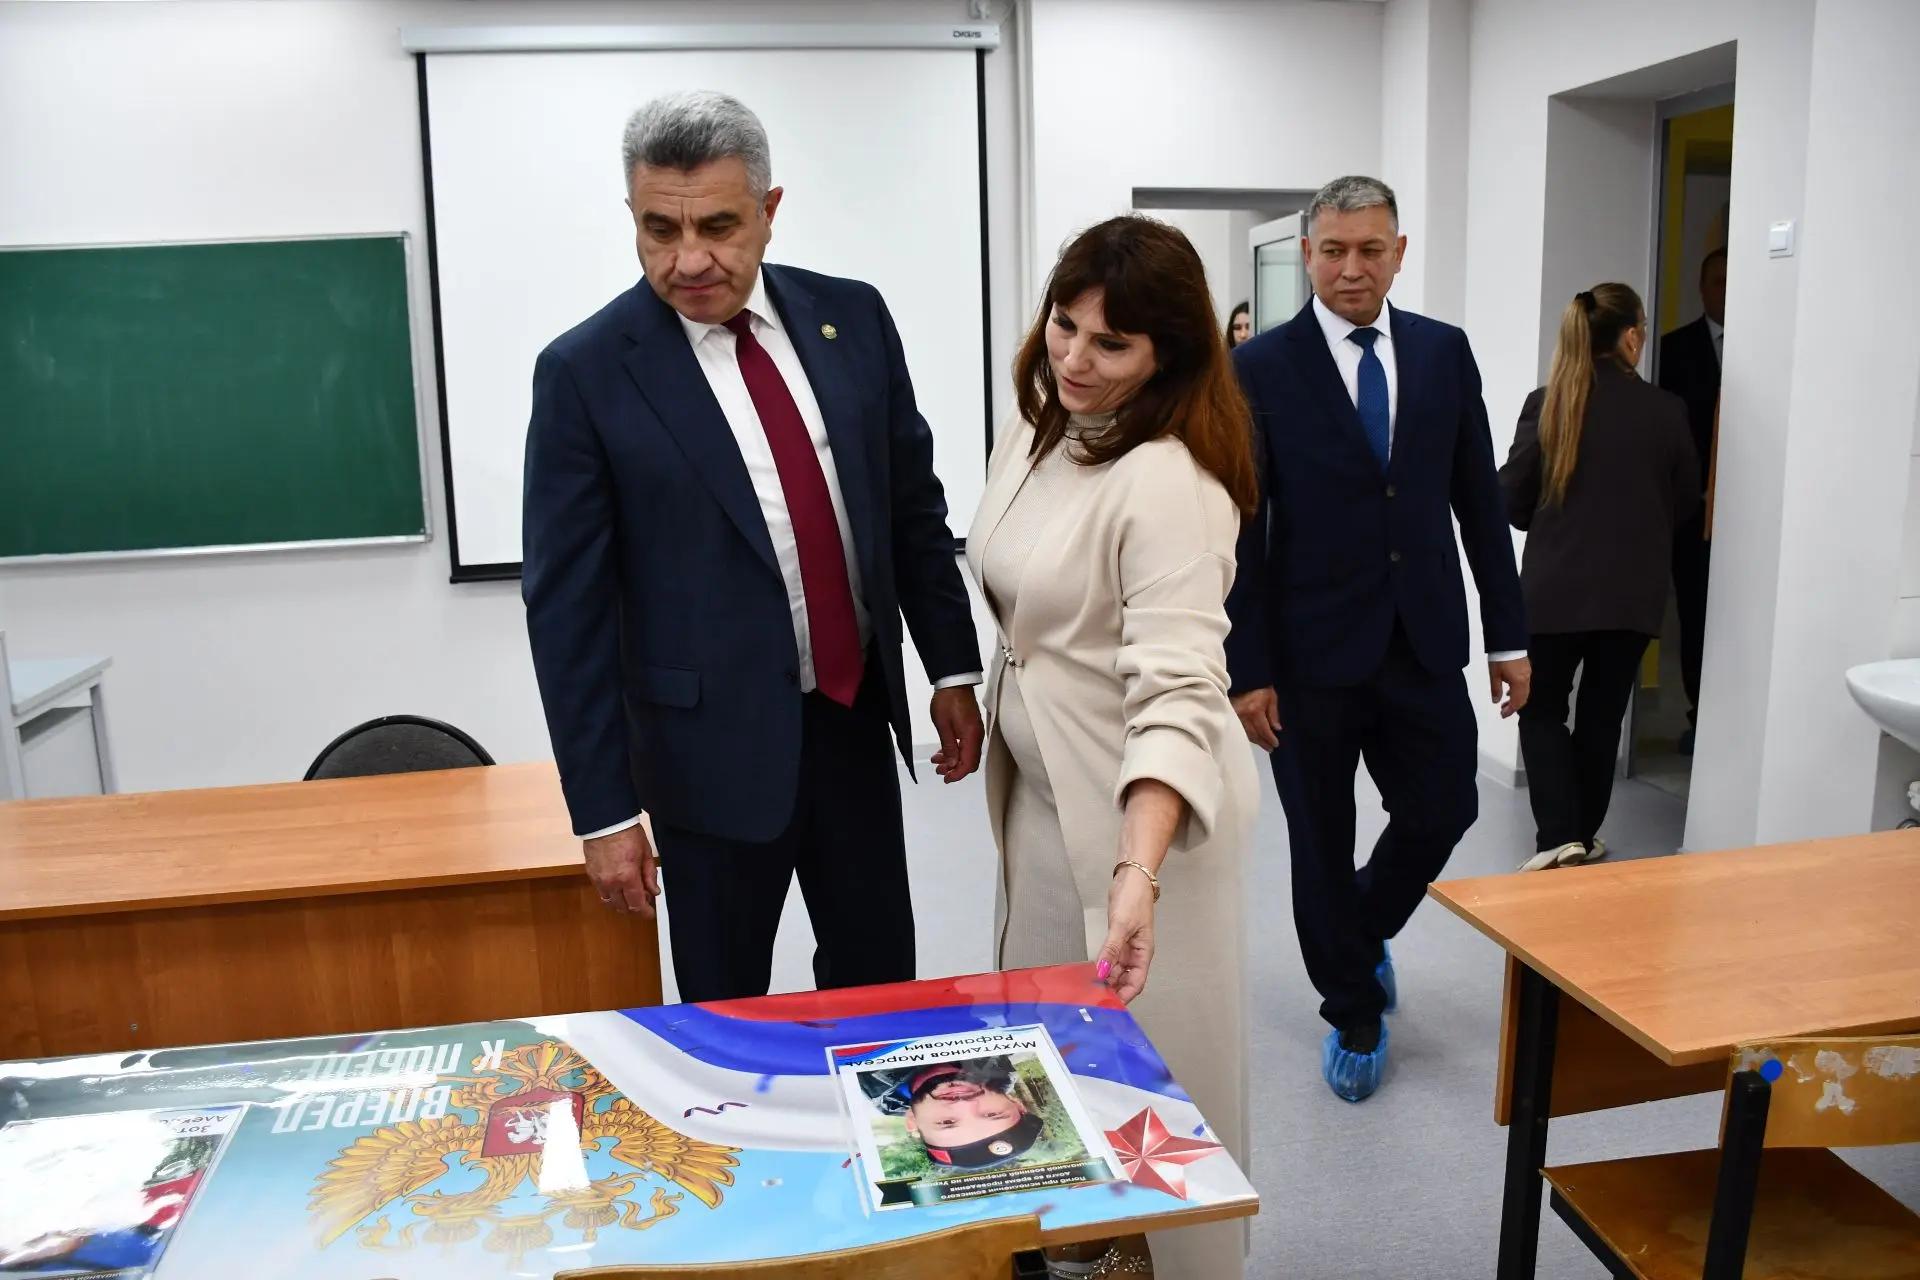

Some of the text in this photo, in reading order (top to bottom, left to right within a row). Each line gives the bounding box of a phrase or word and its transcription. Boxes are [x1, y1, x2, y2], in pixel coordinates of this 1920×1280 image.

[904, 1034, 1013, 1051] Рафаилович
[470, 1039, 505, 1073] К
[845, 1041, 1036, 1067] Мухутдинов Марсель
[271, 1085, 451, 1133] ВПЕРЕД
[1004, 1175, 1032, 1185] время
[1045, 1171, 1071, 1179] долга
[949, 1180, 1003, 1192] проведения
[1042, 1178, 1059, 1186] при
[940, 1188, 987, 1200] воинского
